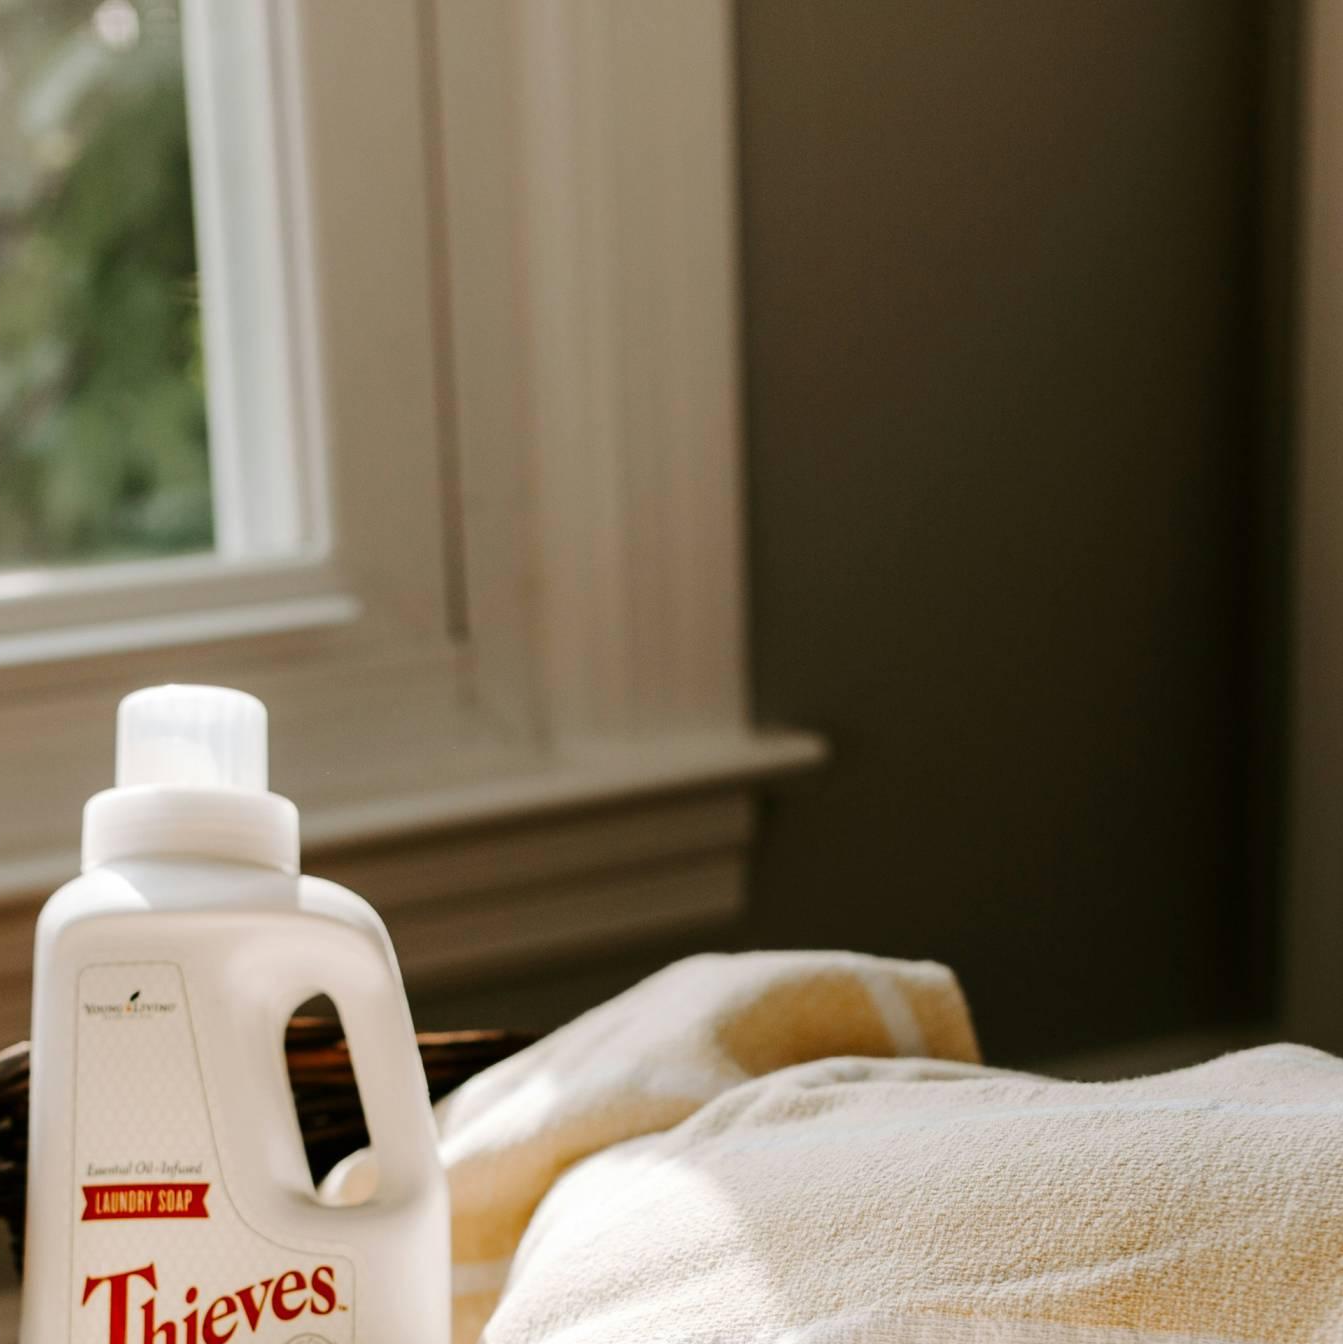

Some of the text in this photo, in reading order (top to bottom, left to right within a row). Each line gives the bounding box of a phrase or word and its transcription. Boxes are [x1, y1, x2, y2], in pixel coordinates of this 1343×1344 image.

[87, 1161, 132, 1176] Essential
[95, 1189, 193, 1214] LAUNDRY SOAP
